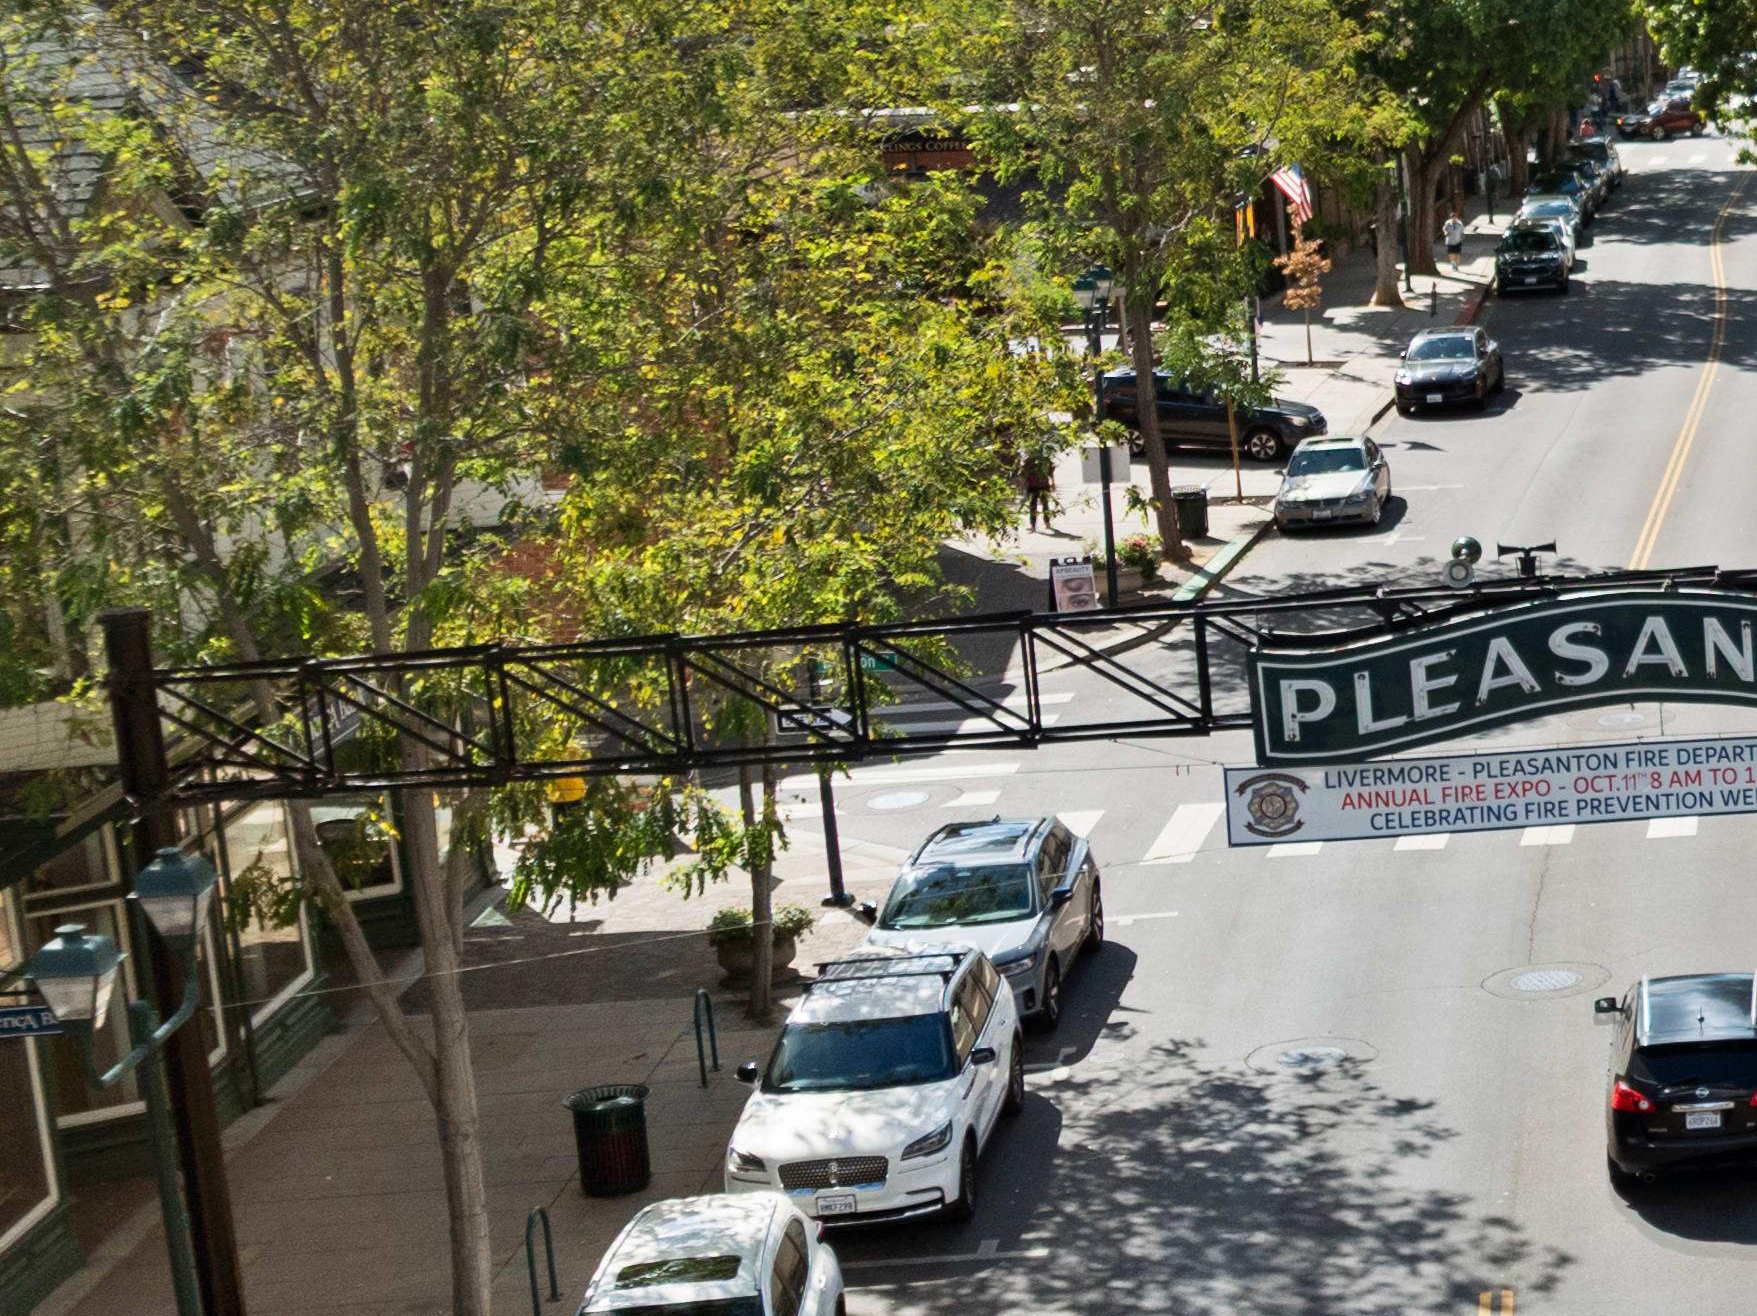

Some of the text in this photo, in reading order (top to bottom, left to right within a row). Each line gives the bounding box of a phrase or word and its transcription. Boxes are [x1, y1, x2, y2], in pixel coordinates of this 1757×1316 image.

[1324, 764, 1451, 789] LIVERMORE
[1473, 752, 1618, 780] PLEASANTON
[1625, 749, 1670, 769] FIRE
[1341, 788, 1436, 810] ANNUAL
[1442, 785, 1486, 804] FIRE
[1494, 779, 1551, 800] EXPO
[1670, 770, 1702, 787] AM
[1709, 767, 1738, 785] TO
[1370, 802, 1518, 831] CELEBRATING
[1525, 799, 1569, 820] FIRE
[1576, 790, 1714, 816] PREVENTION
